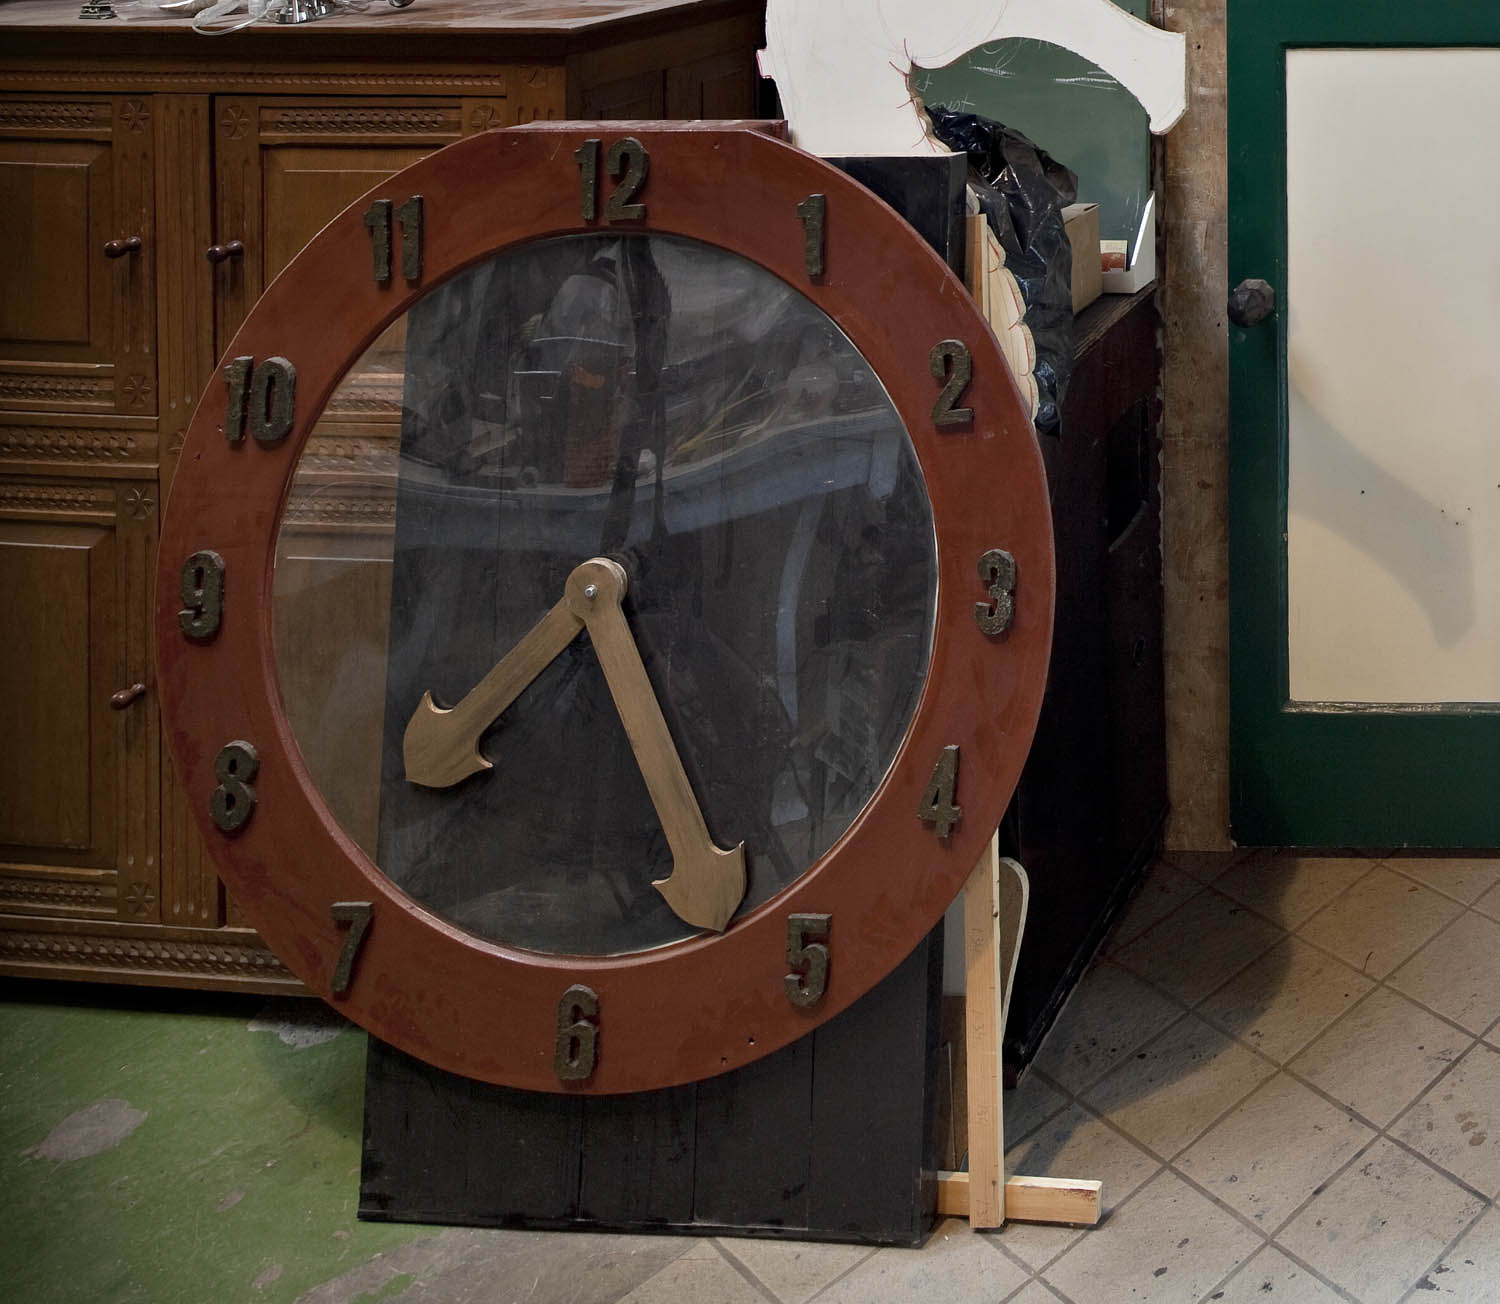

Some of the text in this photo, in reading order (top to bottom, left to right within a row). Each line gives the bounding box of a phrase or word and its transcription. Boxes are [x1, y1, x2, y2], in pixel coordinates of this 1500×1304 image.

[575, 137, 649, 222] 12
[363, 195, 425, 281] 11
[797, 193, 827, 276] 1
[222, 355, 297, 442] 10
[931, 339, 973, 426] 2
[178, 550, 226, 639] 9
[975, 548, 1018, 635] 3
[212, 740, 259, 830] 8
[918, 745, 962, 838] 4
[330, 901, 375, 995] 7
[784, 913, 833, 1007] 5
[557, 984, 599, 1080] 6
